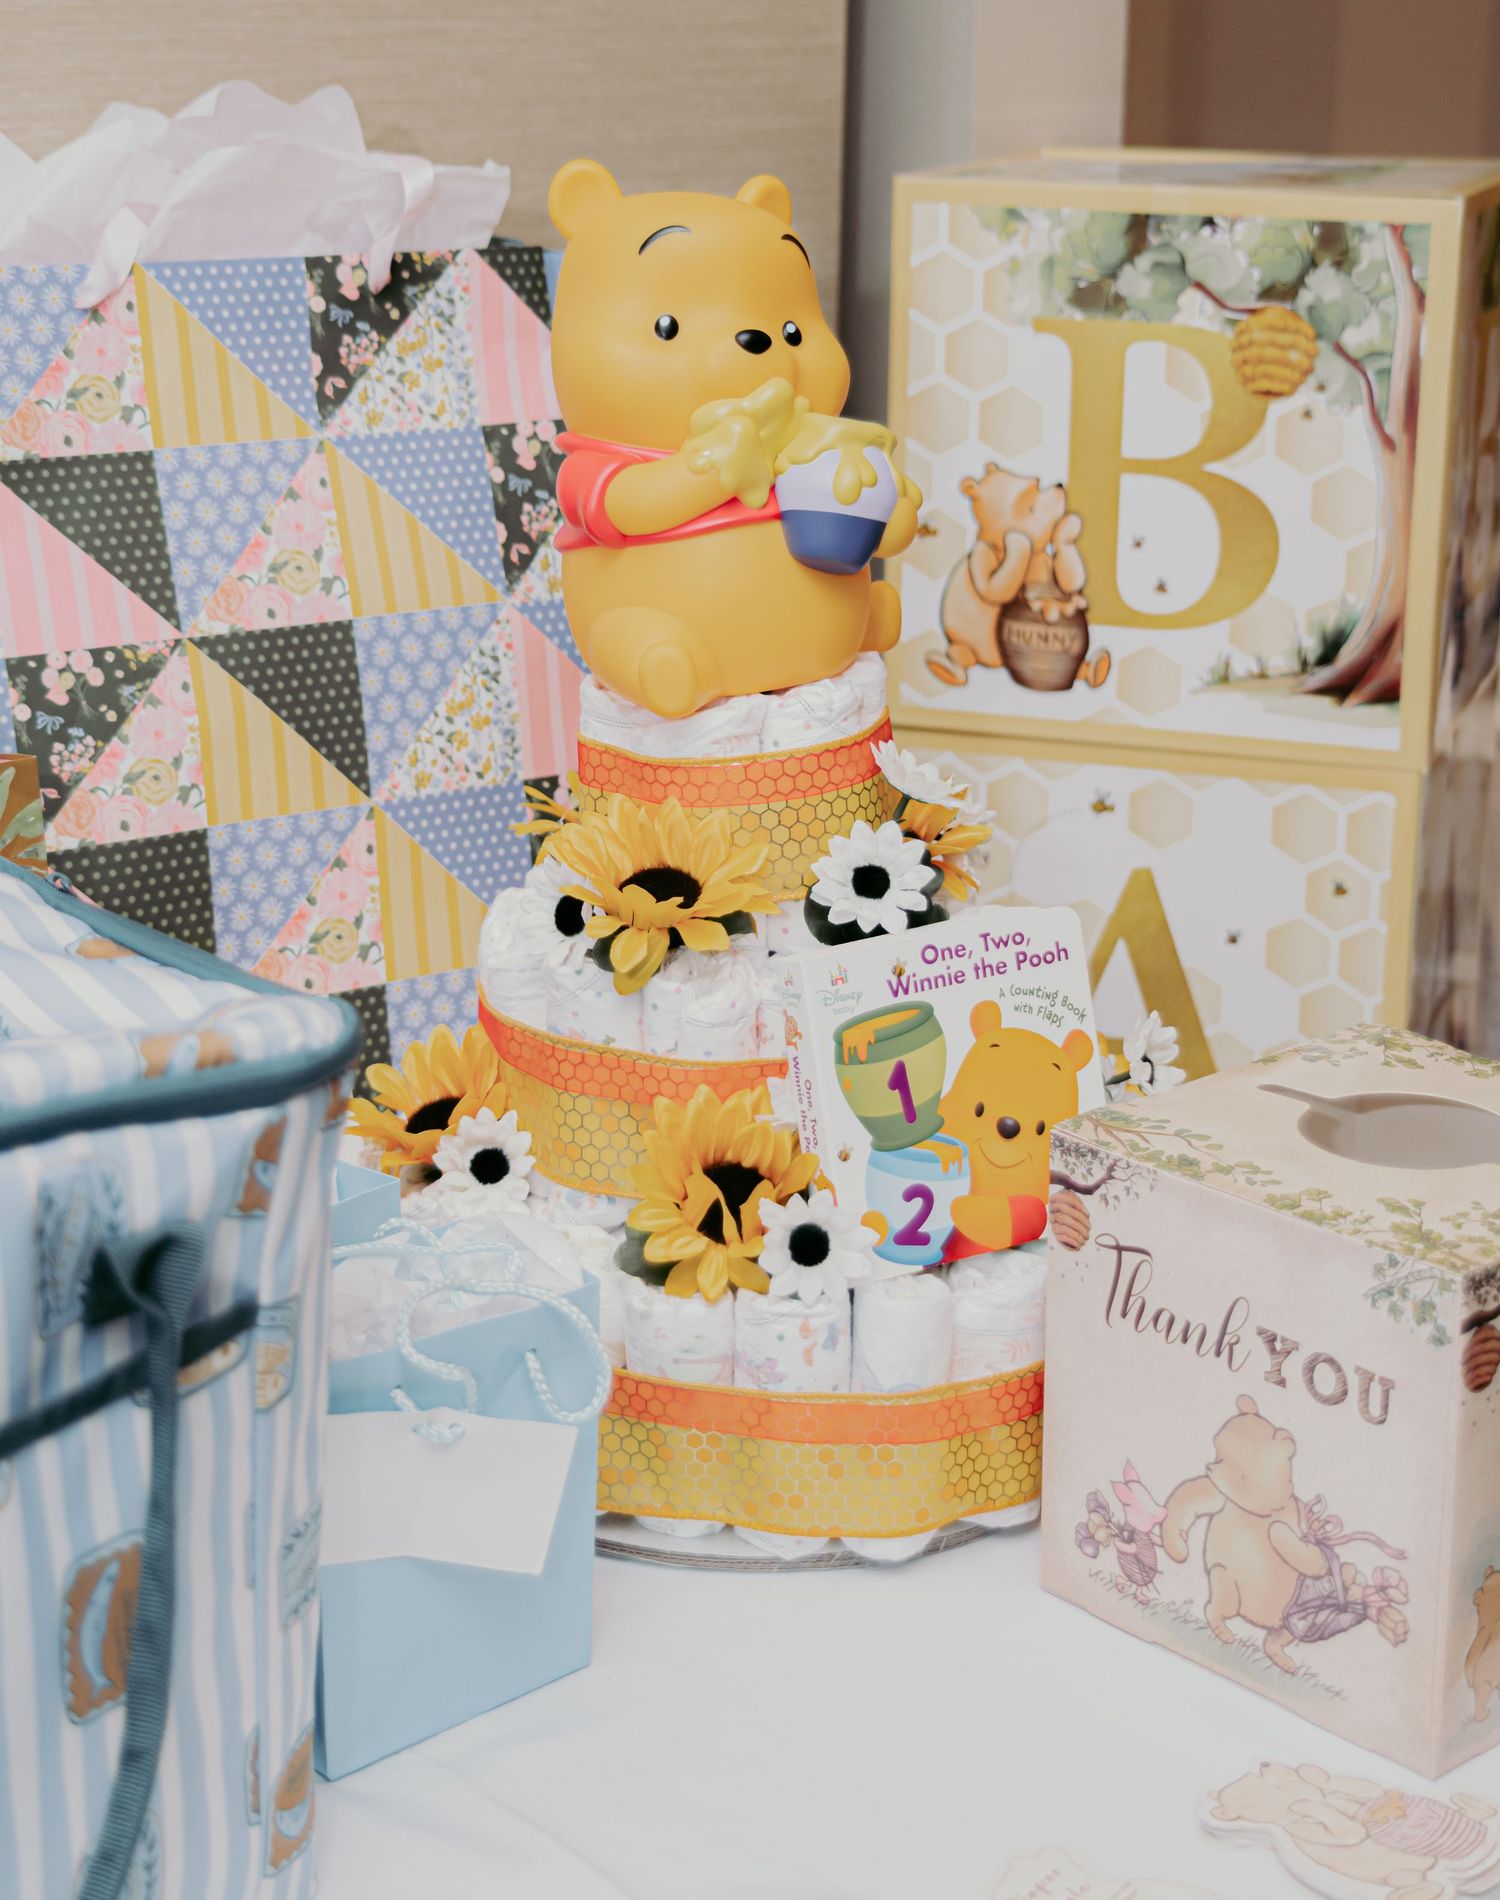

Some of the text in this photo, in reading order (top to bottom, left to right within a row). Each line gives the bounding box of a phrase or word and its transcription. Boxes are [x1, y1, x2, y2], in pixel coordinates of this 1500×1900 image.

[1032, 317, 1280, 630] B
[886, 941, 1069, 998] Winnie the Pooh
[921, 930, 1031, 965] One, Two,
[1092, 866, 1218, 1080] A
[999, 986, 1006, 999] A
[1060, 995, 1088, 1025] Book
[1013, 1001, 1066, 1029] with Flaps
[792, 1056, 804, 1105] Winnie
[800, 1109, 808, 1132] the
[804, 1079, 819, 1149] One, Two,
[888, 1060, 917, 1124] 1
[893, 1183, 935, 1247] 2
[1094, 1233, 1396, 1426] Thank YOU
